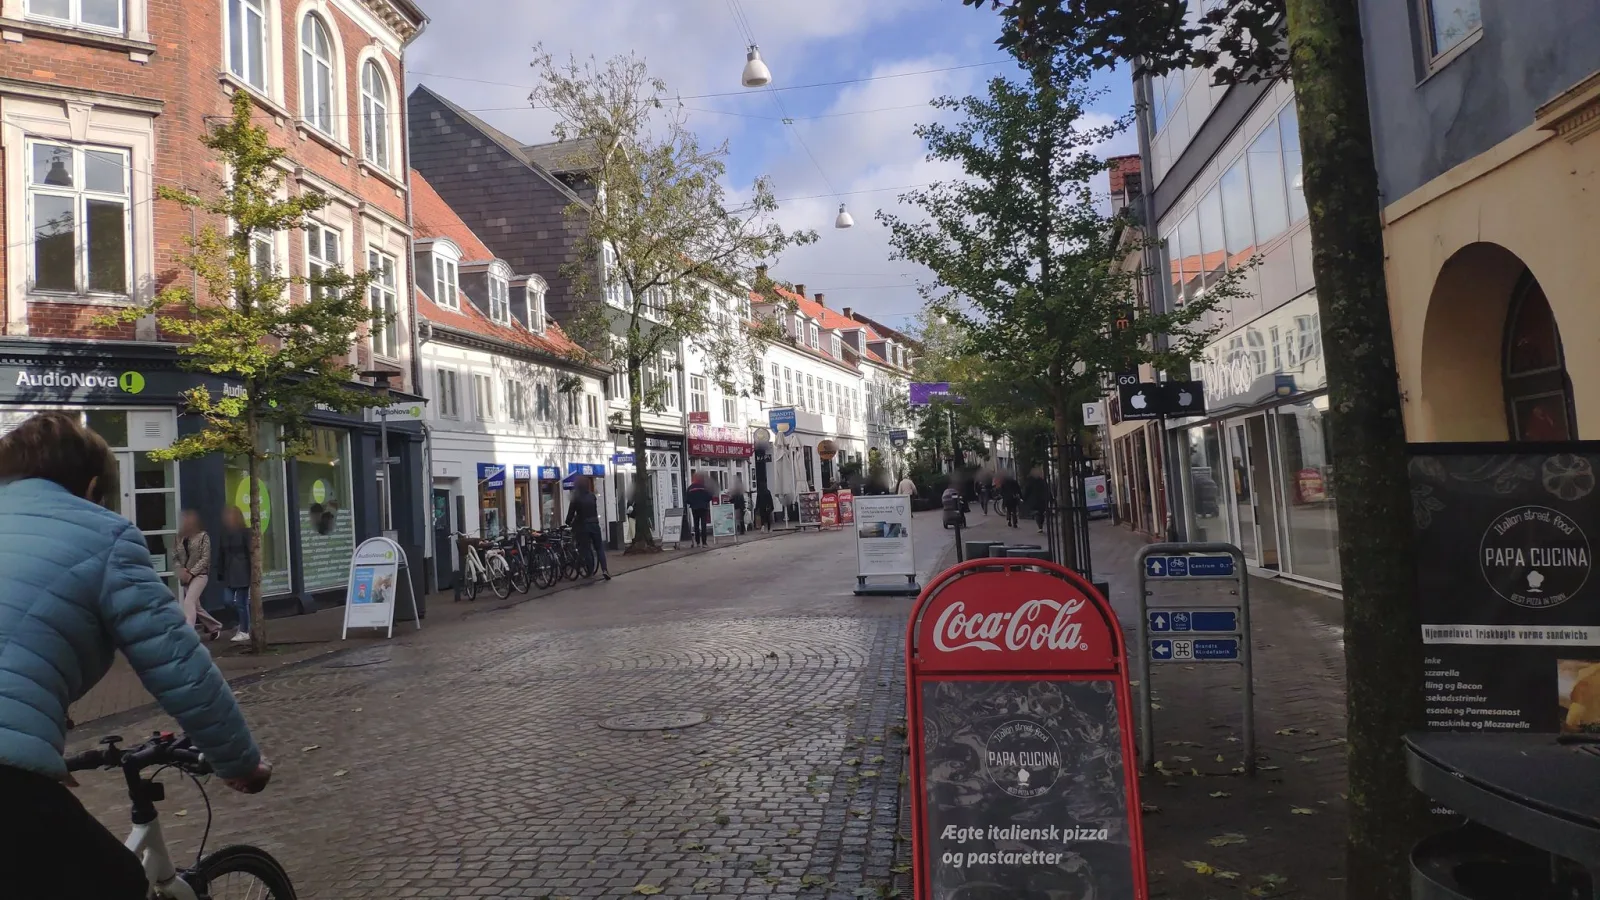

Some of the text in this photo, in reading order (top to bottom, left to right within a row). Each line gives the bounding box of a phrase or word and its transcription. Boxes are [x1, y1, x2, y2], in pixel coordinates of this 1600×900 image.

[15, 371, 118, 388] AudioNova
[1119, 375, 1136, 385] GO
[375, 408, 410, 416] AioNova
[1086, 407, 1095, 419] P
[1493, 509, 1576, 536] Italian street food
[1485, 547, 1589, 567] PAPA CUCINA
[1510, 592, 1567, 606] BEST PIZZA IN TOWN
[932, 598, 1087, 652] Coca-Cola
[1424, 627, 1473, 640] Hjemmelavet
[1519, 630, 1543, 640] varme
[1546, 630, 1588, 641] sandwichs
[1424, 657, 1442, 665] inke
[1425, 681, 1483, 691] lling og Bacon
[1425, 694, 1488, 703] sekødsstrimler
[1453, 708, 1465, 716] og
[1427, 719, 1530, 729] rmaskinke og Mozzarella
[1034, 727, 1050, 743] food
[988, 751, 1060, 766] PAPA CUCINA
[939, 824, 1108, 844] Ægte italiensk pizza
[942, 850, 1063, 868] og pastaretter
